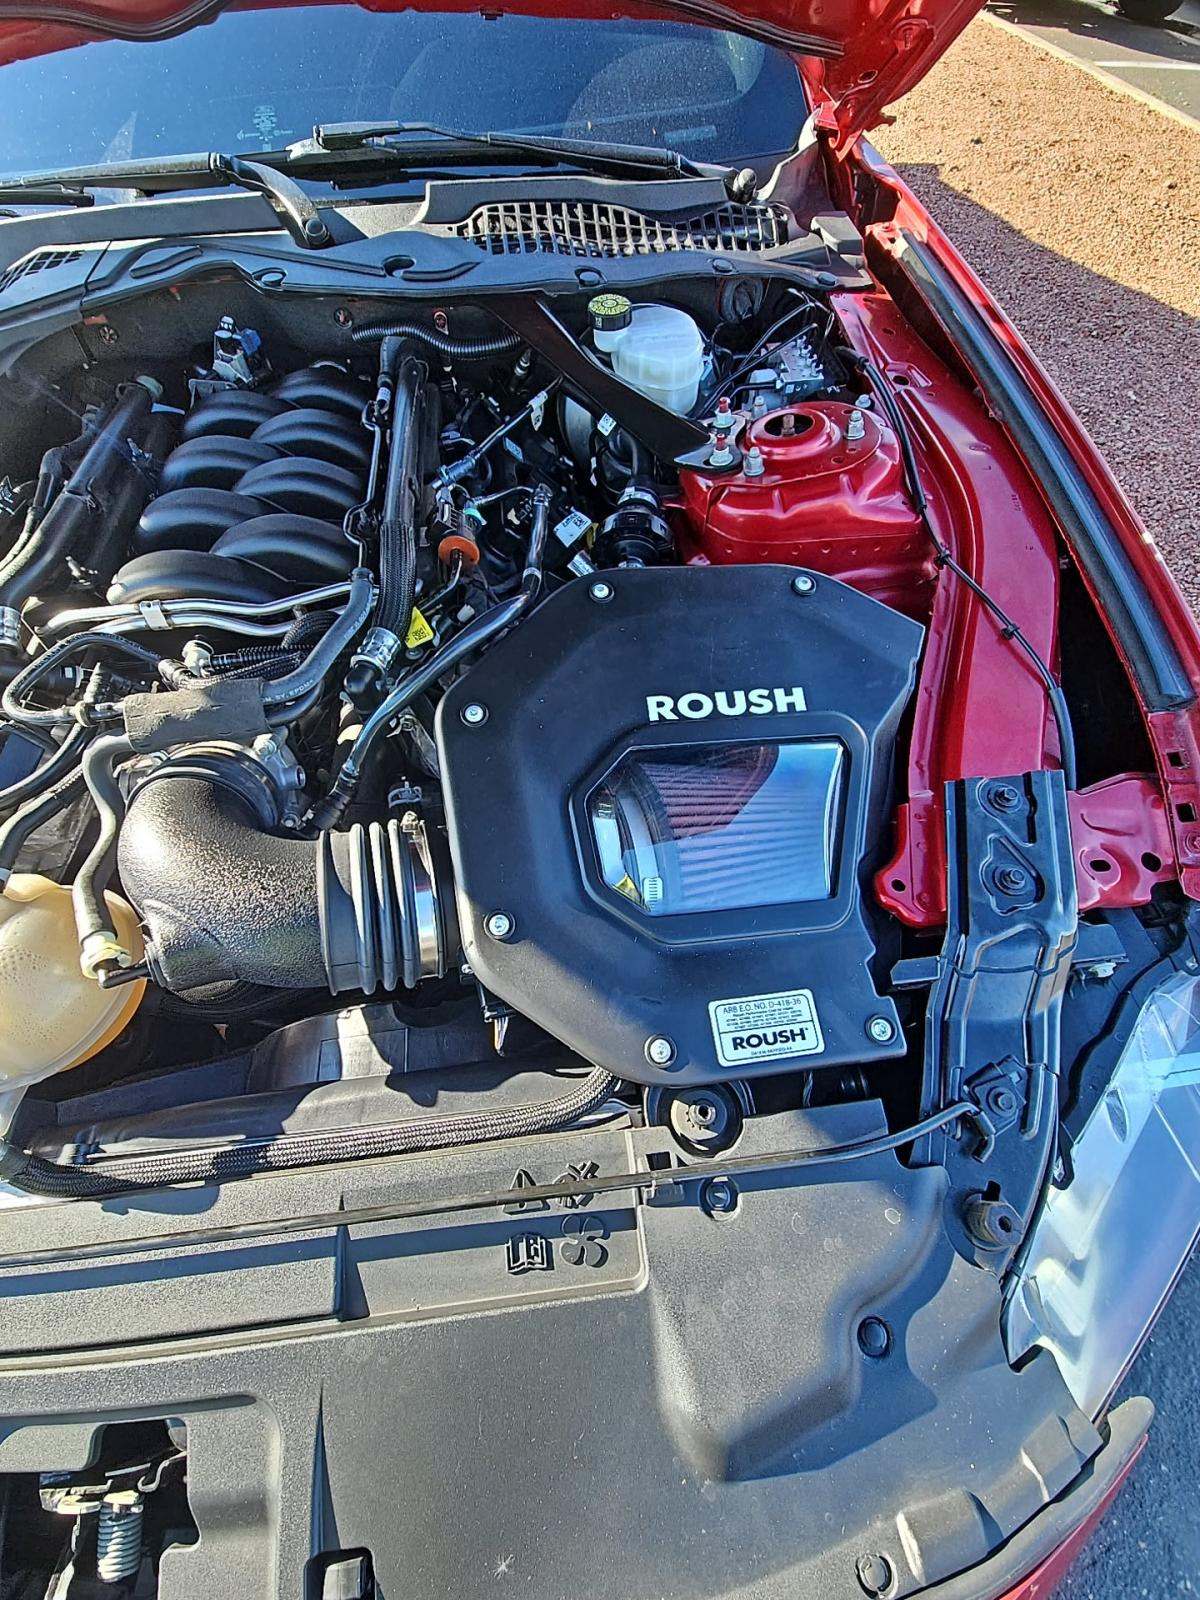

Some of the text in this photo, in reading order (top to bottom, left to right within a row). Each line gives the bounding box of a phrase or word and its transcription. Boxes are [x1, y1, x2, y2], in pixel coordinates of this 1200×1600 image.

[646, 687, 807, 721] ROUSH
[754, 1001, 767, 1010] NO.
[732, 1028, 806, 1050] ROUSH
